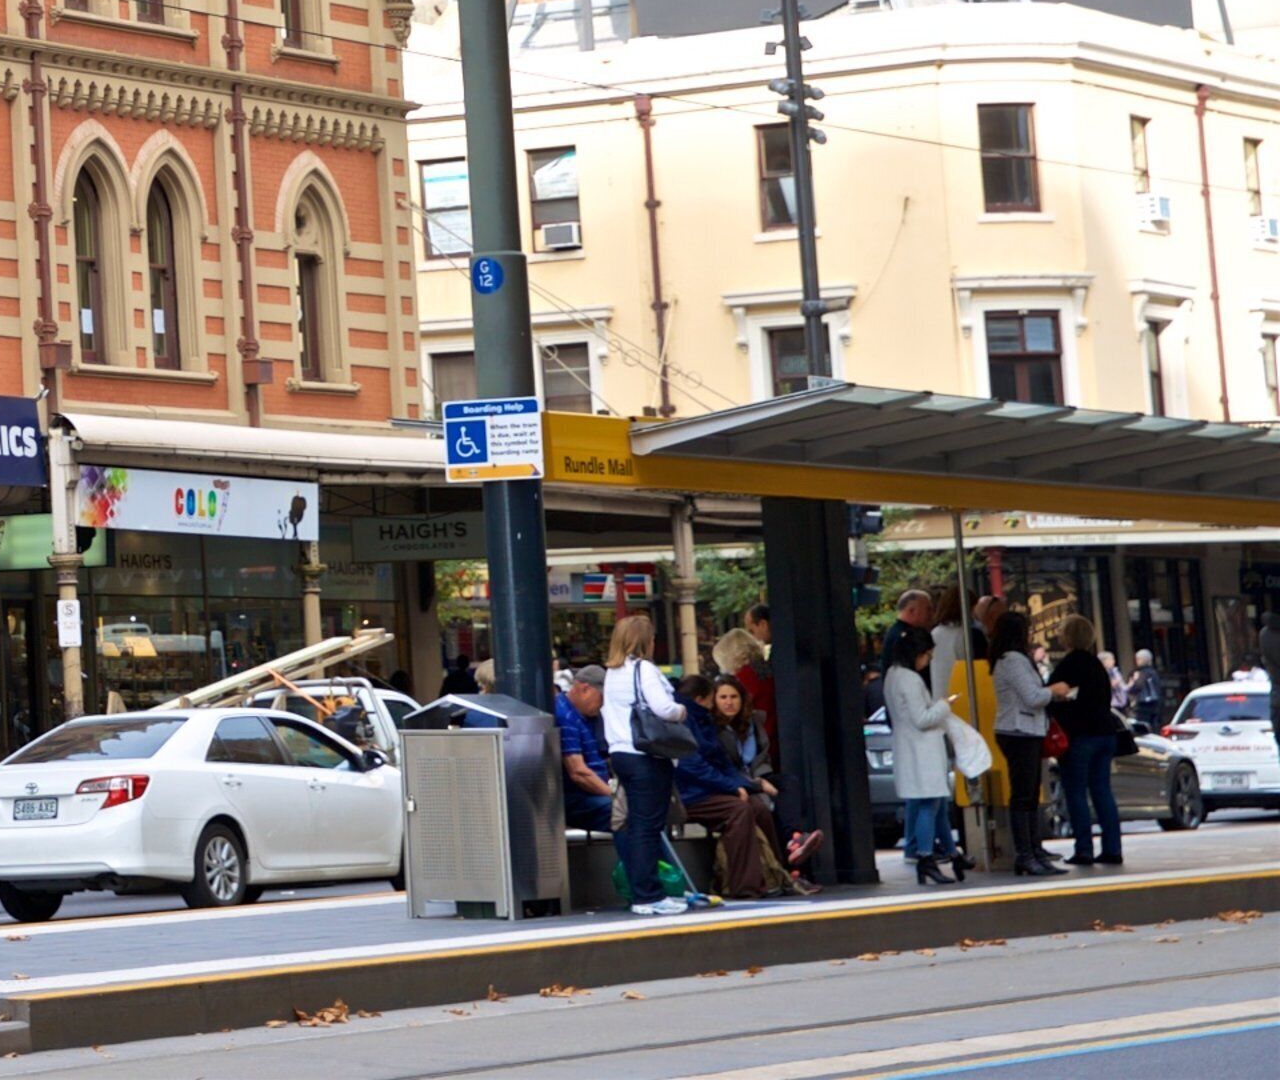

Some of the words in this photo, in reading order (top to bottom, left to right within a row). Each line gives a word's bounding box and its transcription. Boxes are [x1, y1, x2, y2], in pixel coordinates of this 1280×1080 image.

[479, 260, 490, 273] G
[479, 274, 494, 287] 12
[463, 404, 503, 414] Boarding
[503, 403, 524, 412] Help
[563, 456, 605, 475] Rundle
[607, 459, 633, 476] Mall
[379, 521, 468, 541] HAIGH'S
[119, 554, 172, 570] HAIGH'S
